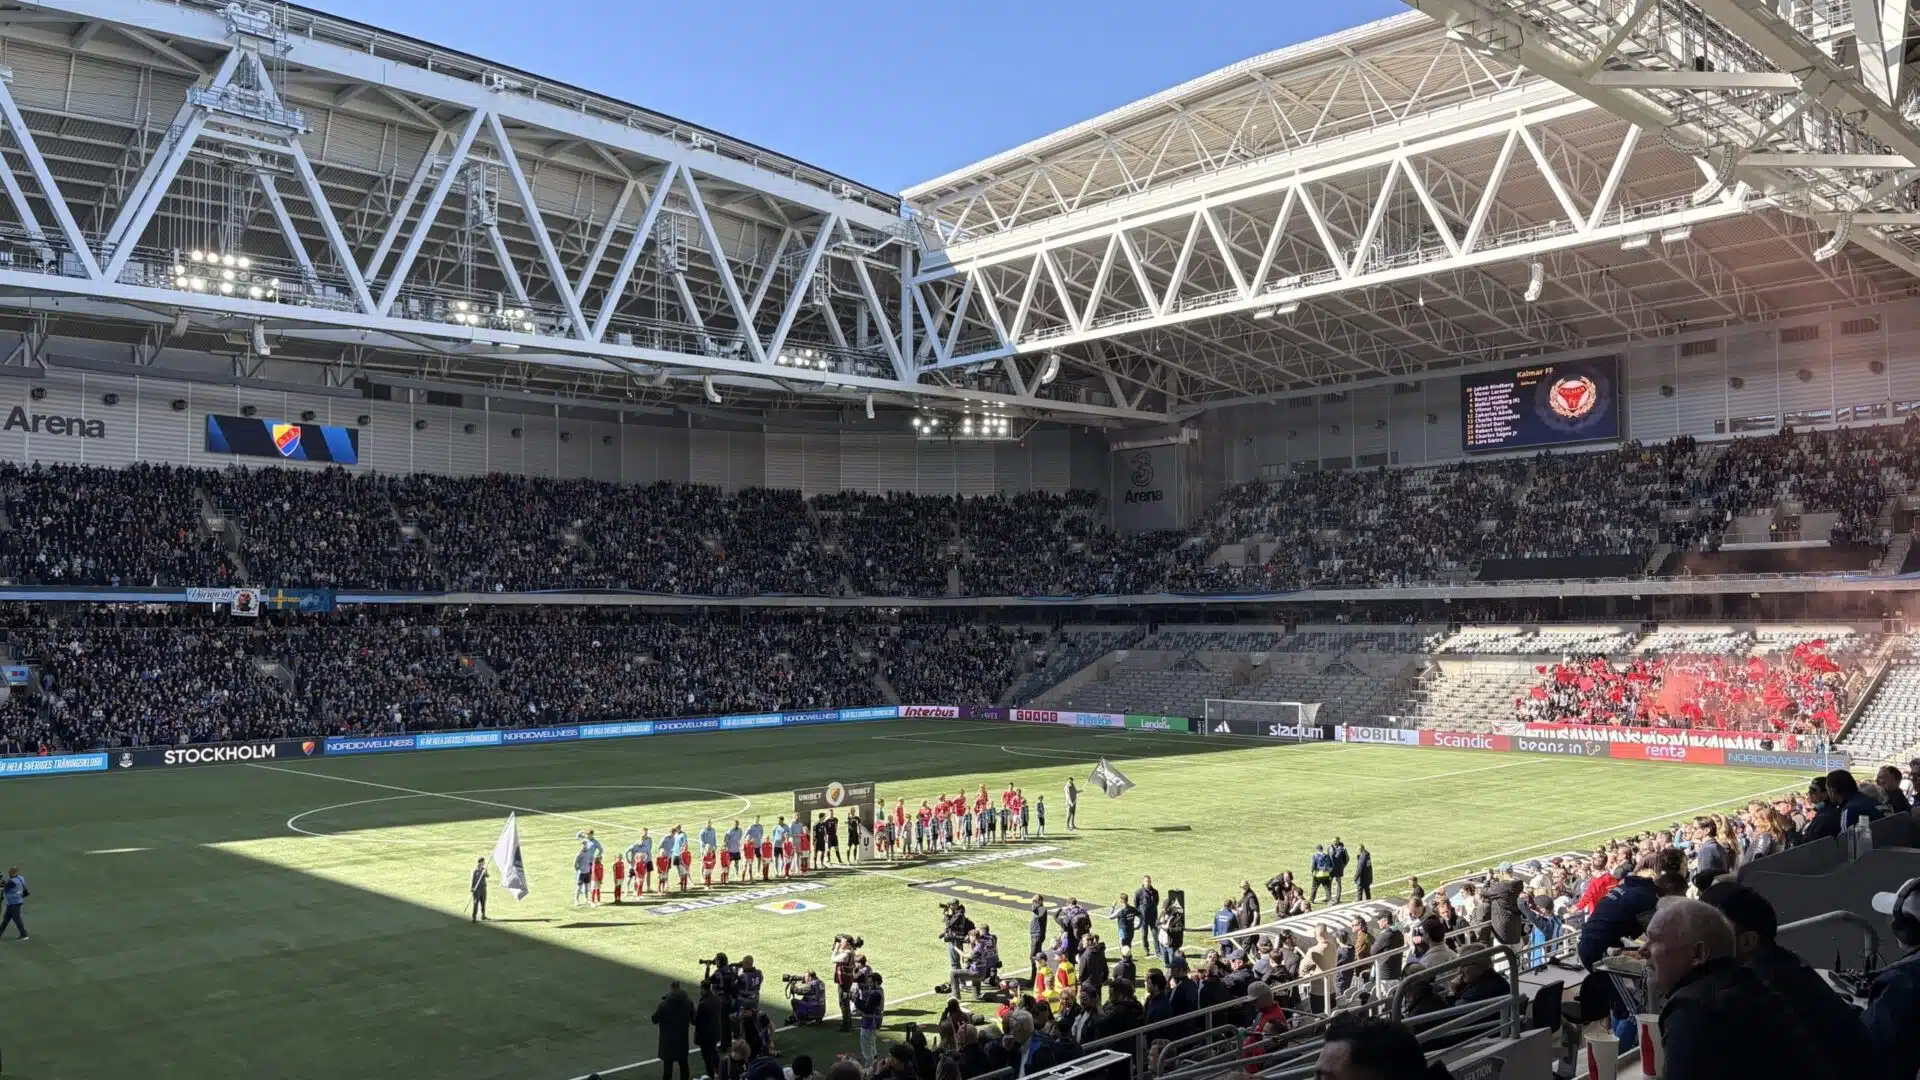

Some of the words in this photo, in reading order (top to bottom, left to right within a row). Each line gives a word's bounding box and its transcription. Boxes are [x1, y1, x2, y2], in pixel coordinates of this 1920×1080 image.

[1517, 370, 1543, 378] Kalmar
[4, 406, 105, 438] Arena
[1131, 451, 1154, 487] 3
[1124, 489, 1163, 505] Arena
[904, 707, 955, 718] Interbus
[503, 729, 578, 741] NORDICWELLNESS
[1269, 723, 1324, 739] stadium
[327, 738, 414, 751] NORDICWELLNESS
[1434, 732, 1494, 749] Scandic
[1518, 738, 1564, 752] beans
[1568, 741, 1582, 754] in
[164, 744, 276, 765] STOCKHOLM
[1645, 744, 1686, 758] renta
[23, 759, 53, 771] SVERIGES
[1727, 753, 1845, 768] NORDICWELLNESS
[798, 792, 822, 801] UNIBET
[848, 787, 871, 796] UNIBET
